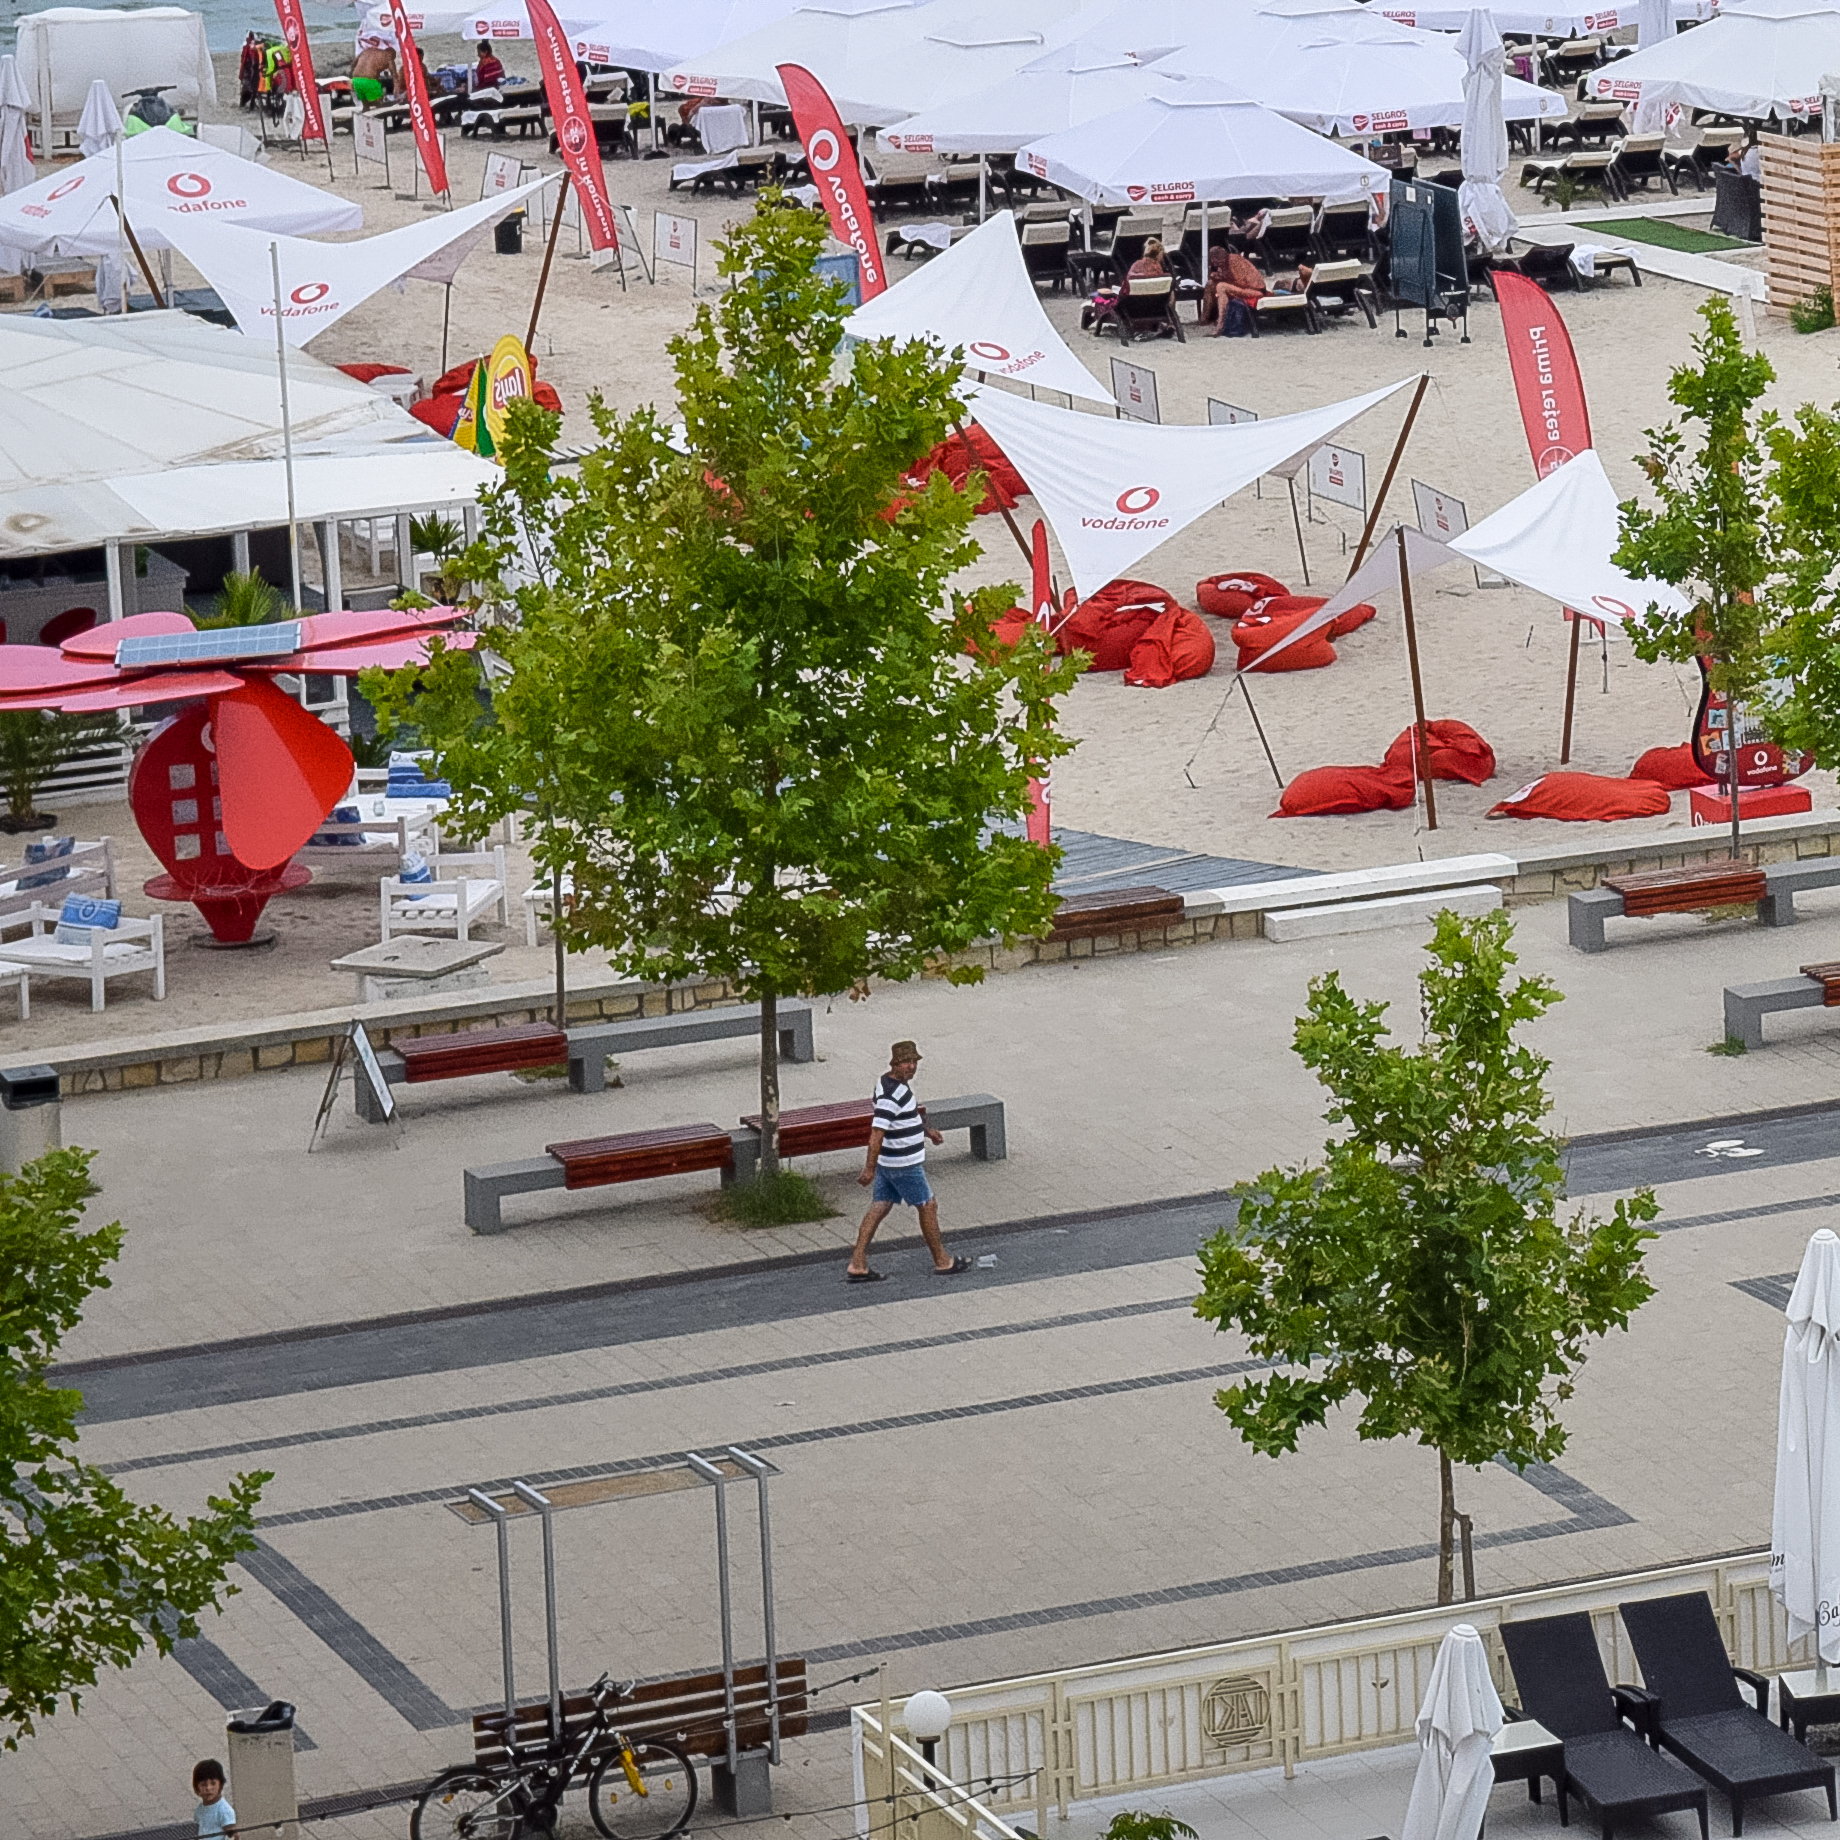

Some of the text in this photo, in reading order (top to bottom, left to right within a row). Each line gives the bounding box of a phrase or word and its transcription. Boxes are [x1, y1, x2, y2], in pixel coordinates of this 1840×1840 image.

[491, 20, 520, 28] SELGROS
[689, 75, 718, 86] SELGROS
[1614, 80, 1642, 89] SELGROS
[1371, 110, 1407, 120] SELGROS
[904, 135, 933, 143] SELGROS
[1151, 181, 1195, 192] SELGROS
[167, 198, 247, 213] dafone
[1081, 517, 1170, 530] vodafone
[1747, 765, 1778, 776] vodafone
